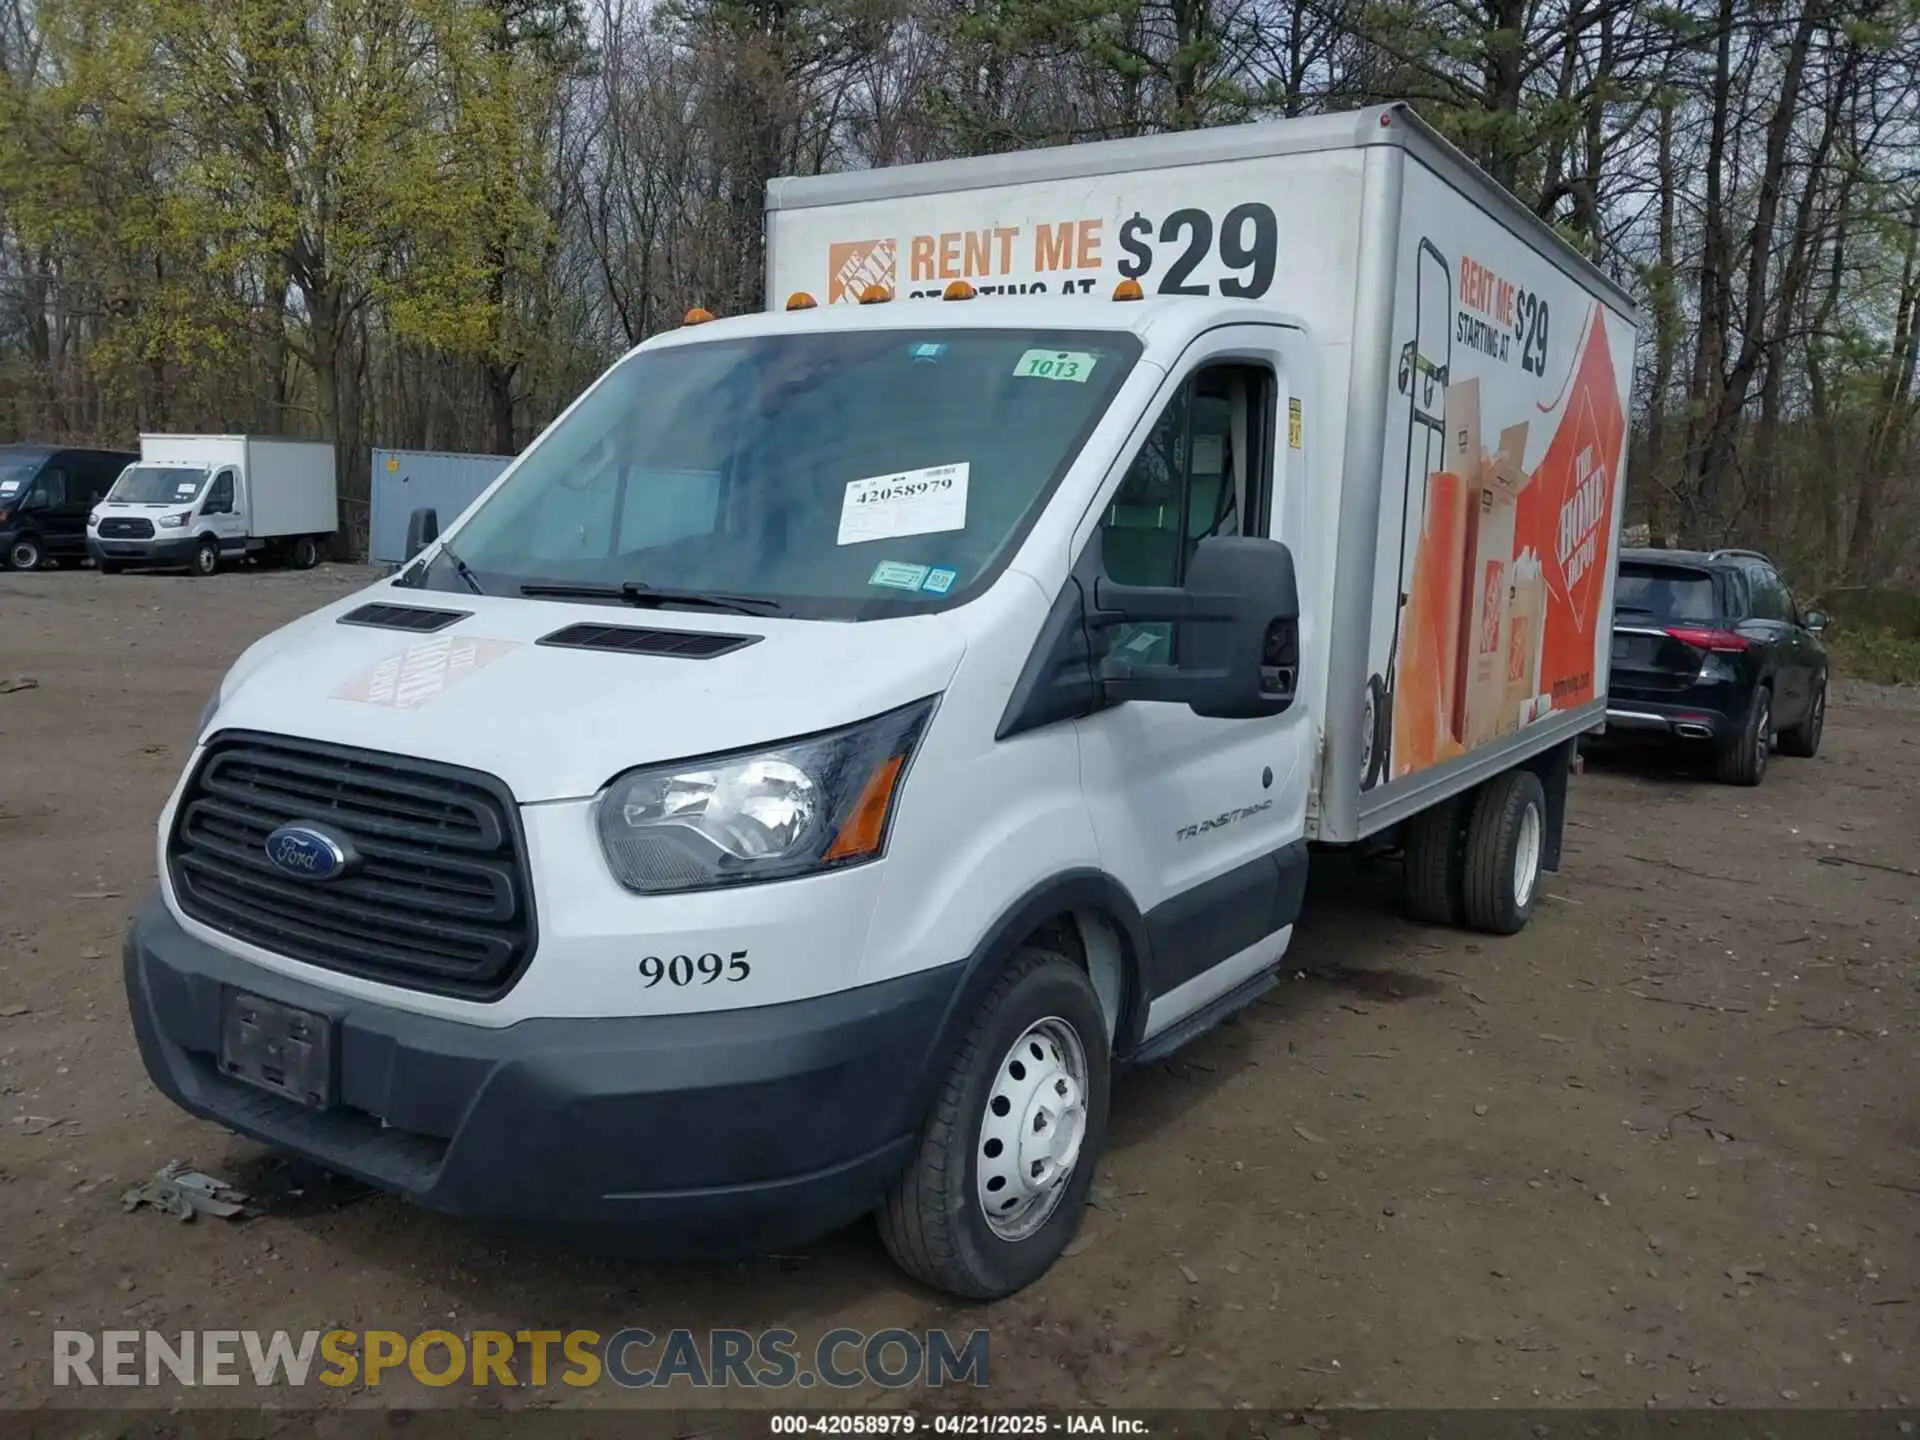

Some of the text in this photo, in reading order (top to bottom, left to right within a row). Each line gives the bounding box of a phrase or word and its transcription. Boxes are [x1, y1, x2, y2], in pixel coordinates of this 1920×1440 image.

[910, 219, 1102, 282] RENT ME
[1117, 202, 1278, 299] $29
[1460, 255, 1515, 328] RENT ME
[1456, 311, 1511, 363] STARTING AT
[1514, 282, 1549, 379] $29
[1029, 359, 1079, 378] 1013
[856, 478, 953, 504] 42058979
[276, 835, 320, 871] Ford
[639, 949, 750, 989] 9095
